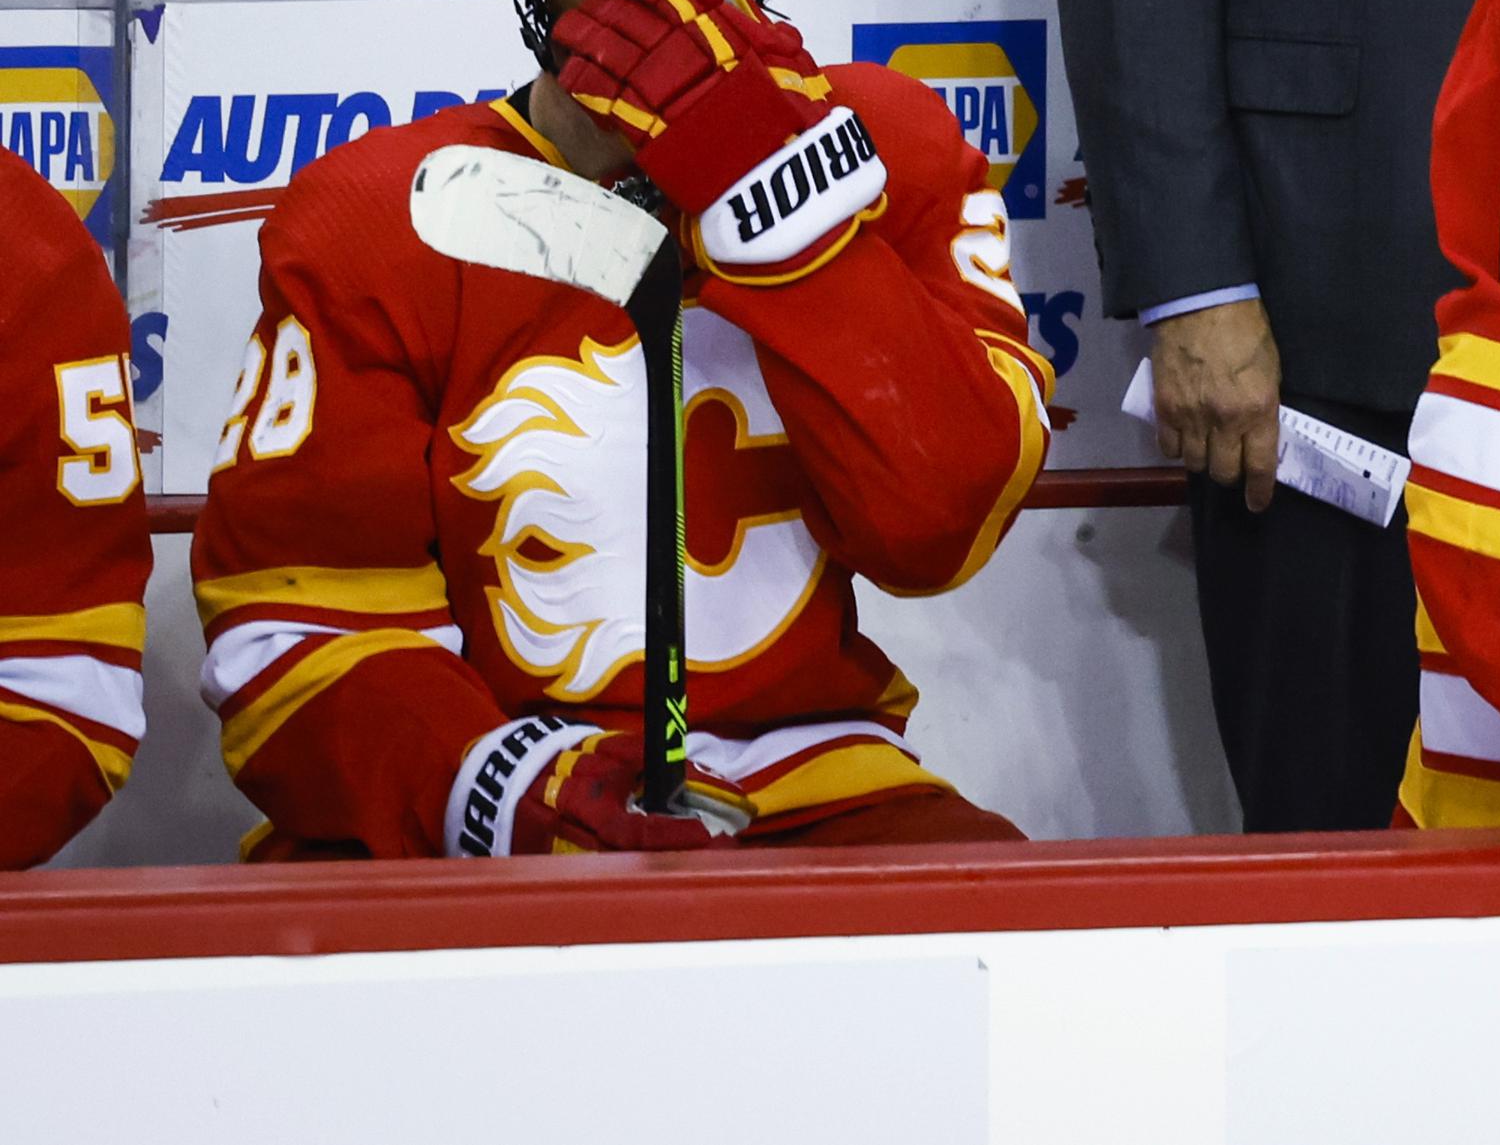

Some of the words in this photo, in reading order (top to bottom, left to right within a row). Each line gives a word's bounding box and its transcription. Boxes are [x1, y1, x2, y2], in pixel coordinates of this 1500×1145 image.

[0, 111, 94, 182] APA
[930, 86, 1009, 156] PA
[54, 353, 142, 506] 5
